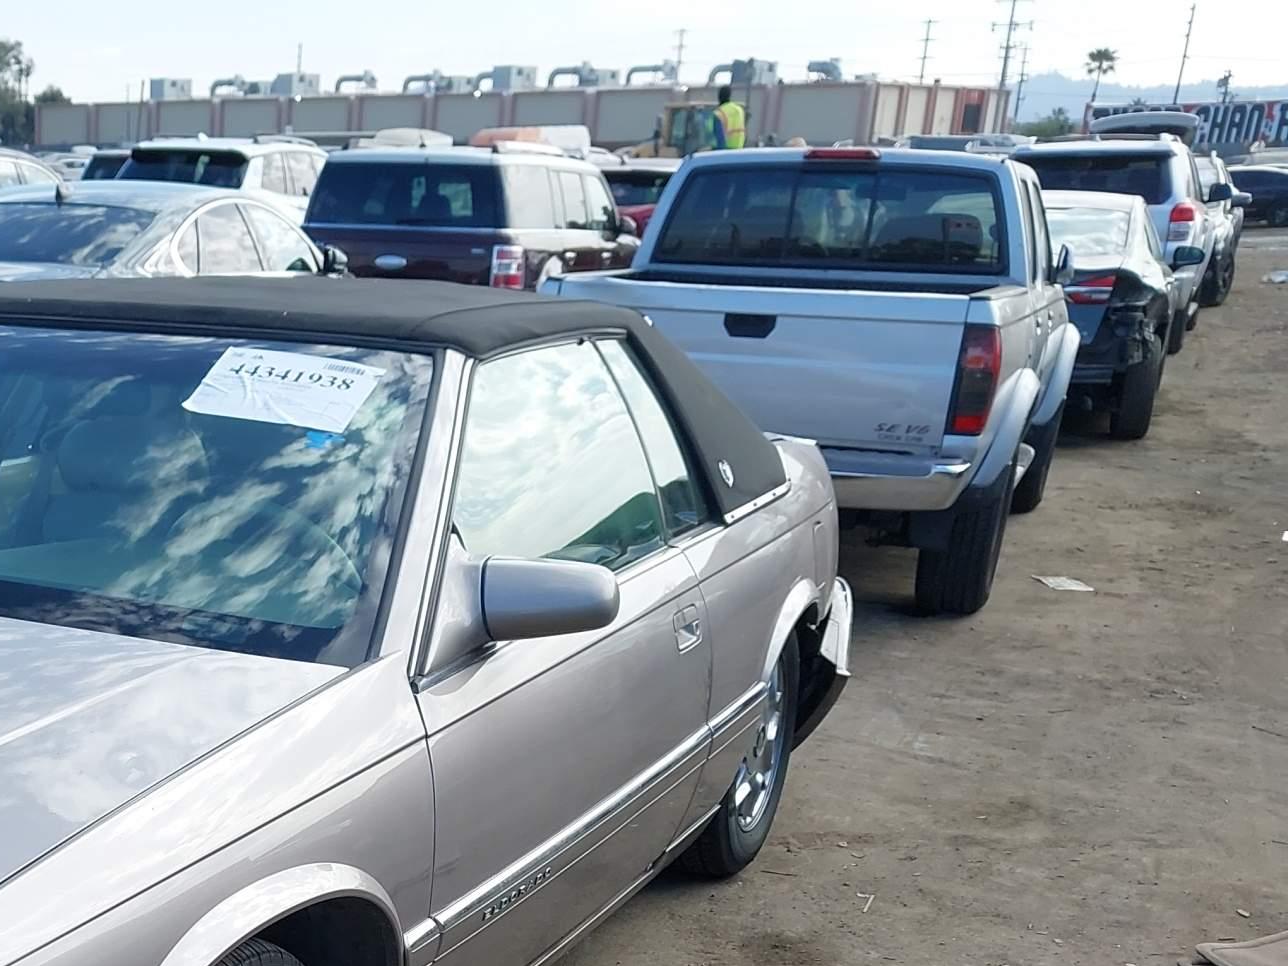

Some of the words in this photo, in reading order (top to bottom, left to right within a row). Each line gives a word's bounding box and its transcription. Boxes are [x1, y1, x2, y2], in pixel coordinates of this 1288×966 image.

[229, 363, 355, 390] 44341938
[873, 422, 902, 433] SE
[905, 424, 930, 435] V6
